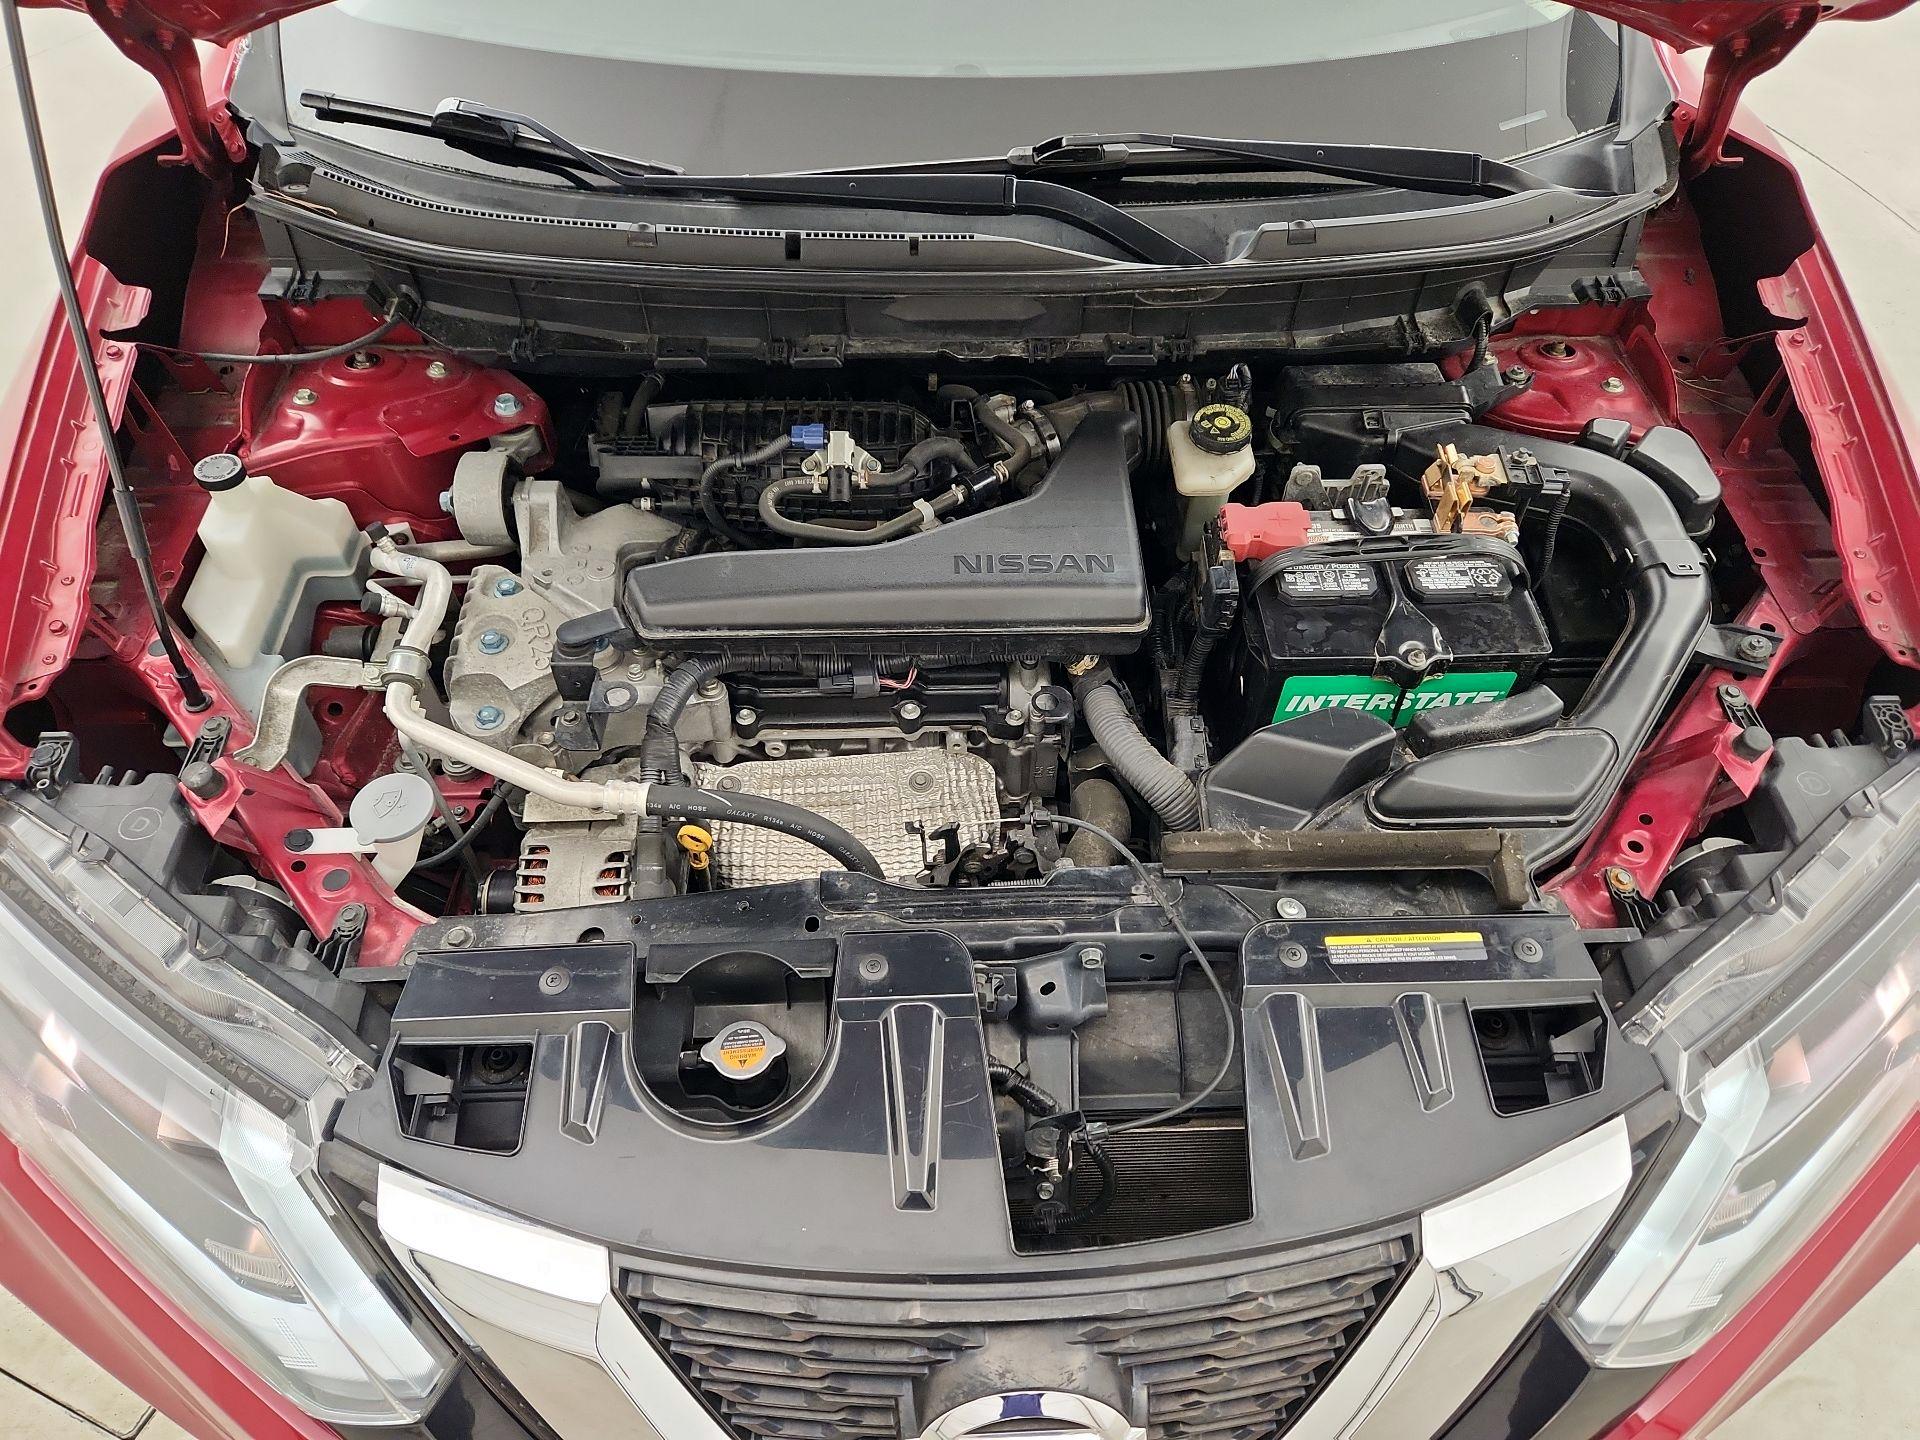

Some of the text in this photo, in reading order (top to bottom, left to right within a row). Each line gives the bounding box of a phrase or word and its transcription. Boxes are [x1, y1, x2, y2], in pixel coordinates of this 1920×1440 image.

[953, 554, 1115, 574] NISSAN
[1284, 691, 1499, 712] INTERSTATE
[726, 809, 758, 819] GALAXY
[790, 822, 802, 831] A/C
[807, 829, 826, 841] HOSE
